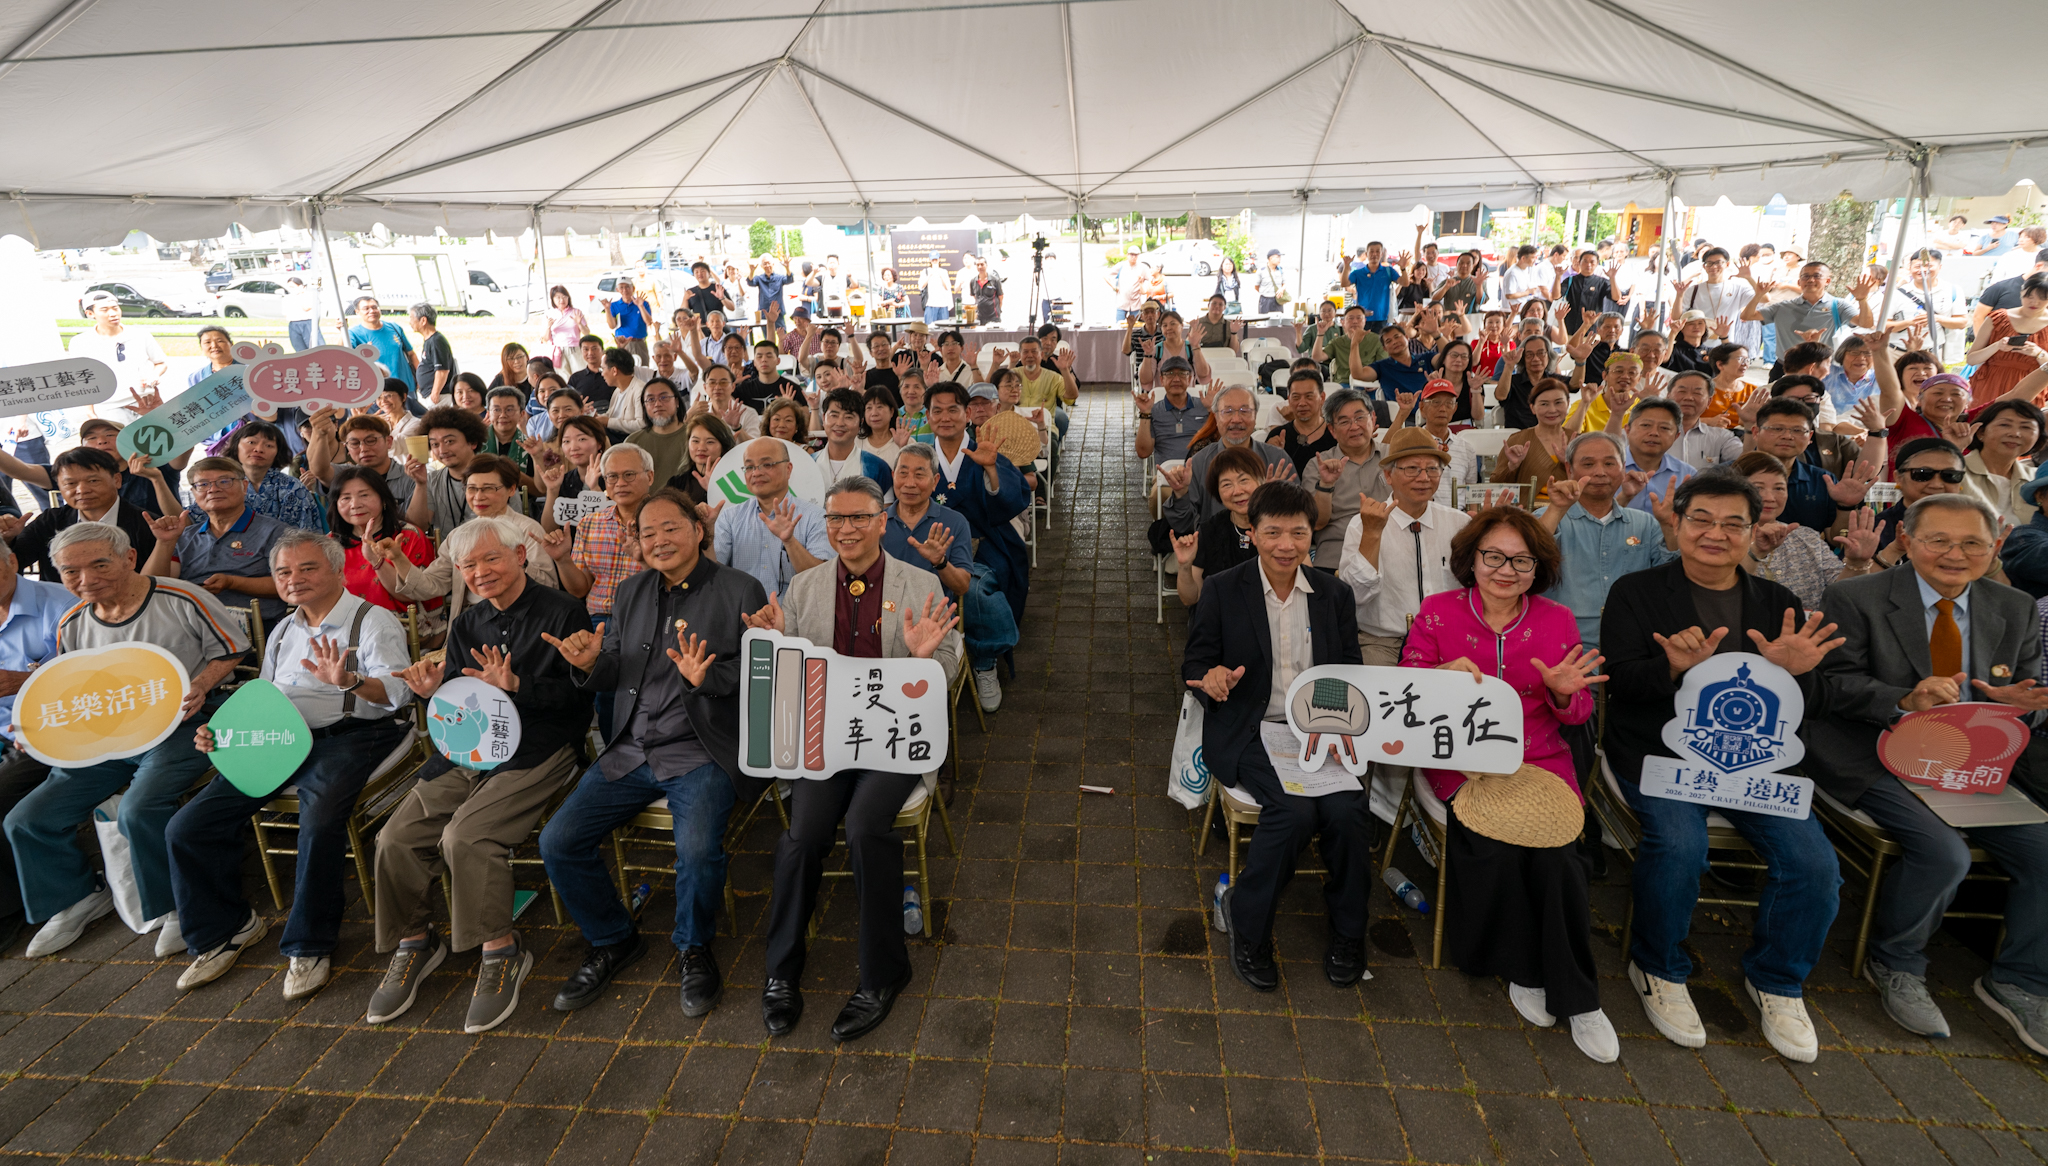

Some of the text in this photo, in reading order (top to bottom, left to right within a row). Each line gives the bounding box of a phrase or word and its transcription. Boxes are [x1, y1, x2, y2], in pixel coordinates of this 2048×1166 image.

[0, 368, 96, 396] 臺灣工藝季
[2, 385, 101, 407] Taiwan Craft Festival
[272, 361, 362, 395] 漫幸福
[168, 375, 243, 428] 臺灣工藝季
[181, 394, 250, 437] Taiwan Craft Festiv
[582, 495, 602, 503] 2026
[37, 677, 169, 731] 是樂活事
[852, 668, 896, 714] 漫
[235, 728, 296, 746] 工藝中心
[491, 698, 509, 759] 工藝節
[844, 713, 931, 761] 幸福
[1379, 682, 1518, 759] 活自在
[1910, 757, 2003, 790] 工藝節
[1664, 788, 1683, 797] 2026
[1688, 791, 1707, 800] 2027
[1711, 794, 1741, 805] CRAFT
[1743, 800, 1799, 815] PILGRIMAGE
